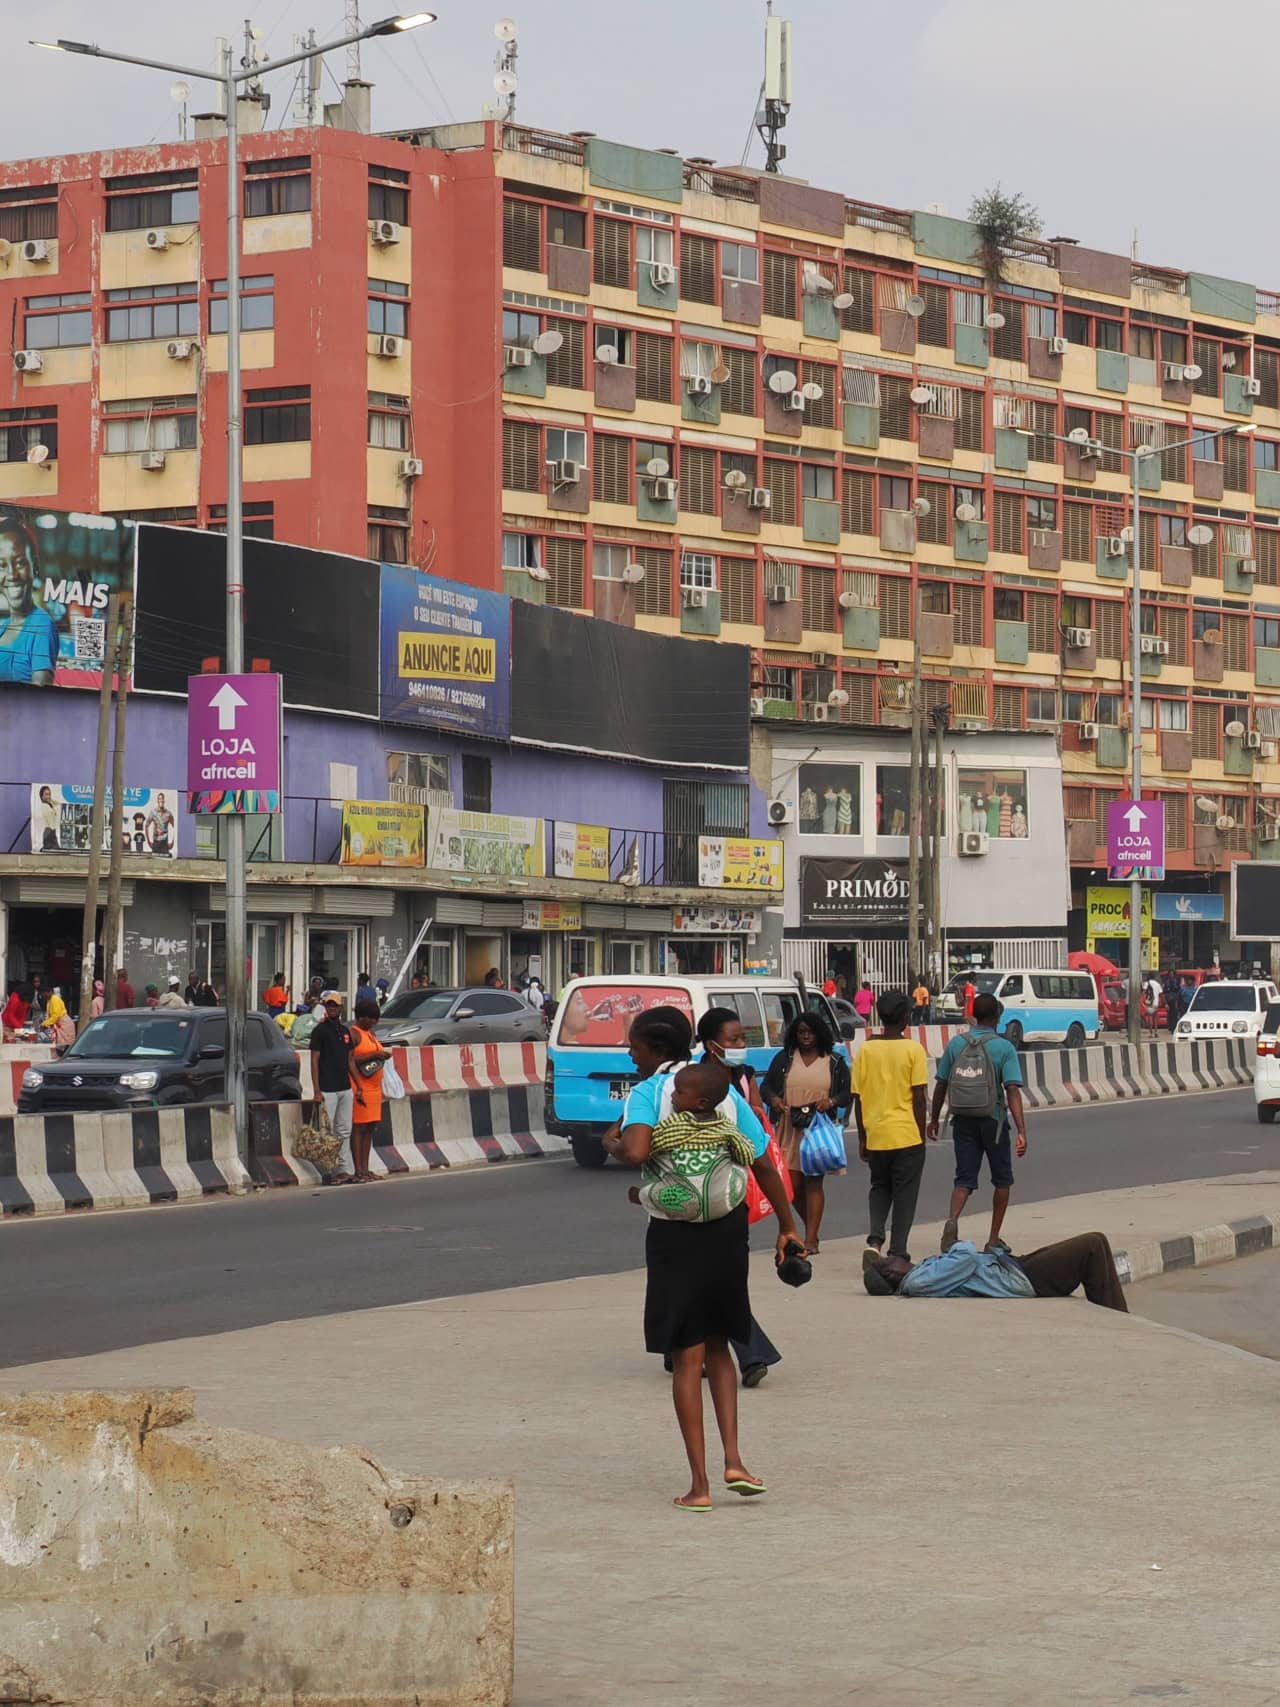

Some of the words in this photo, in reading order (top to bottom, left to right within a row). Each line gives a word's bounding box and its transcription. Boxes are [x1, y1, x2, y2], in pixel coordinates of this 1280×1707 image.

[44, 577, 109, 608] MAIS
[403, 643, 460, 672] ANUNCIE
[464, 647, 492, 675] AQUI
[201, 738, 256, 756] LOJA
[201, 762, 256, 780] africell
[131, 787, 143, 797] YE
[1118, 836, 1151, 847] LOJA
[1118, 850, 1152, 860] africell
